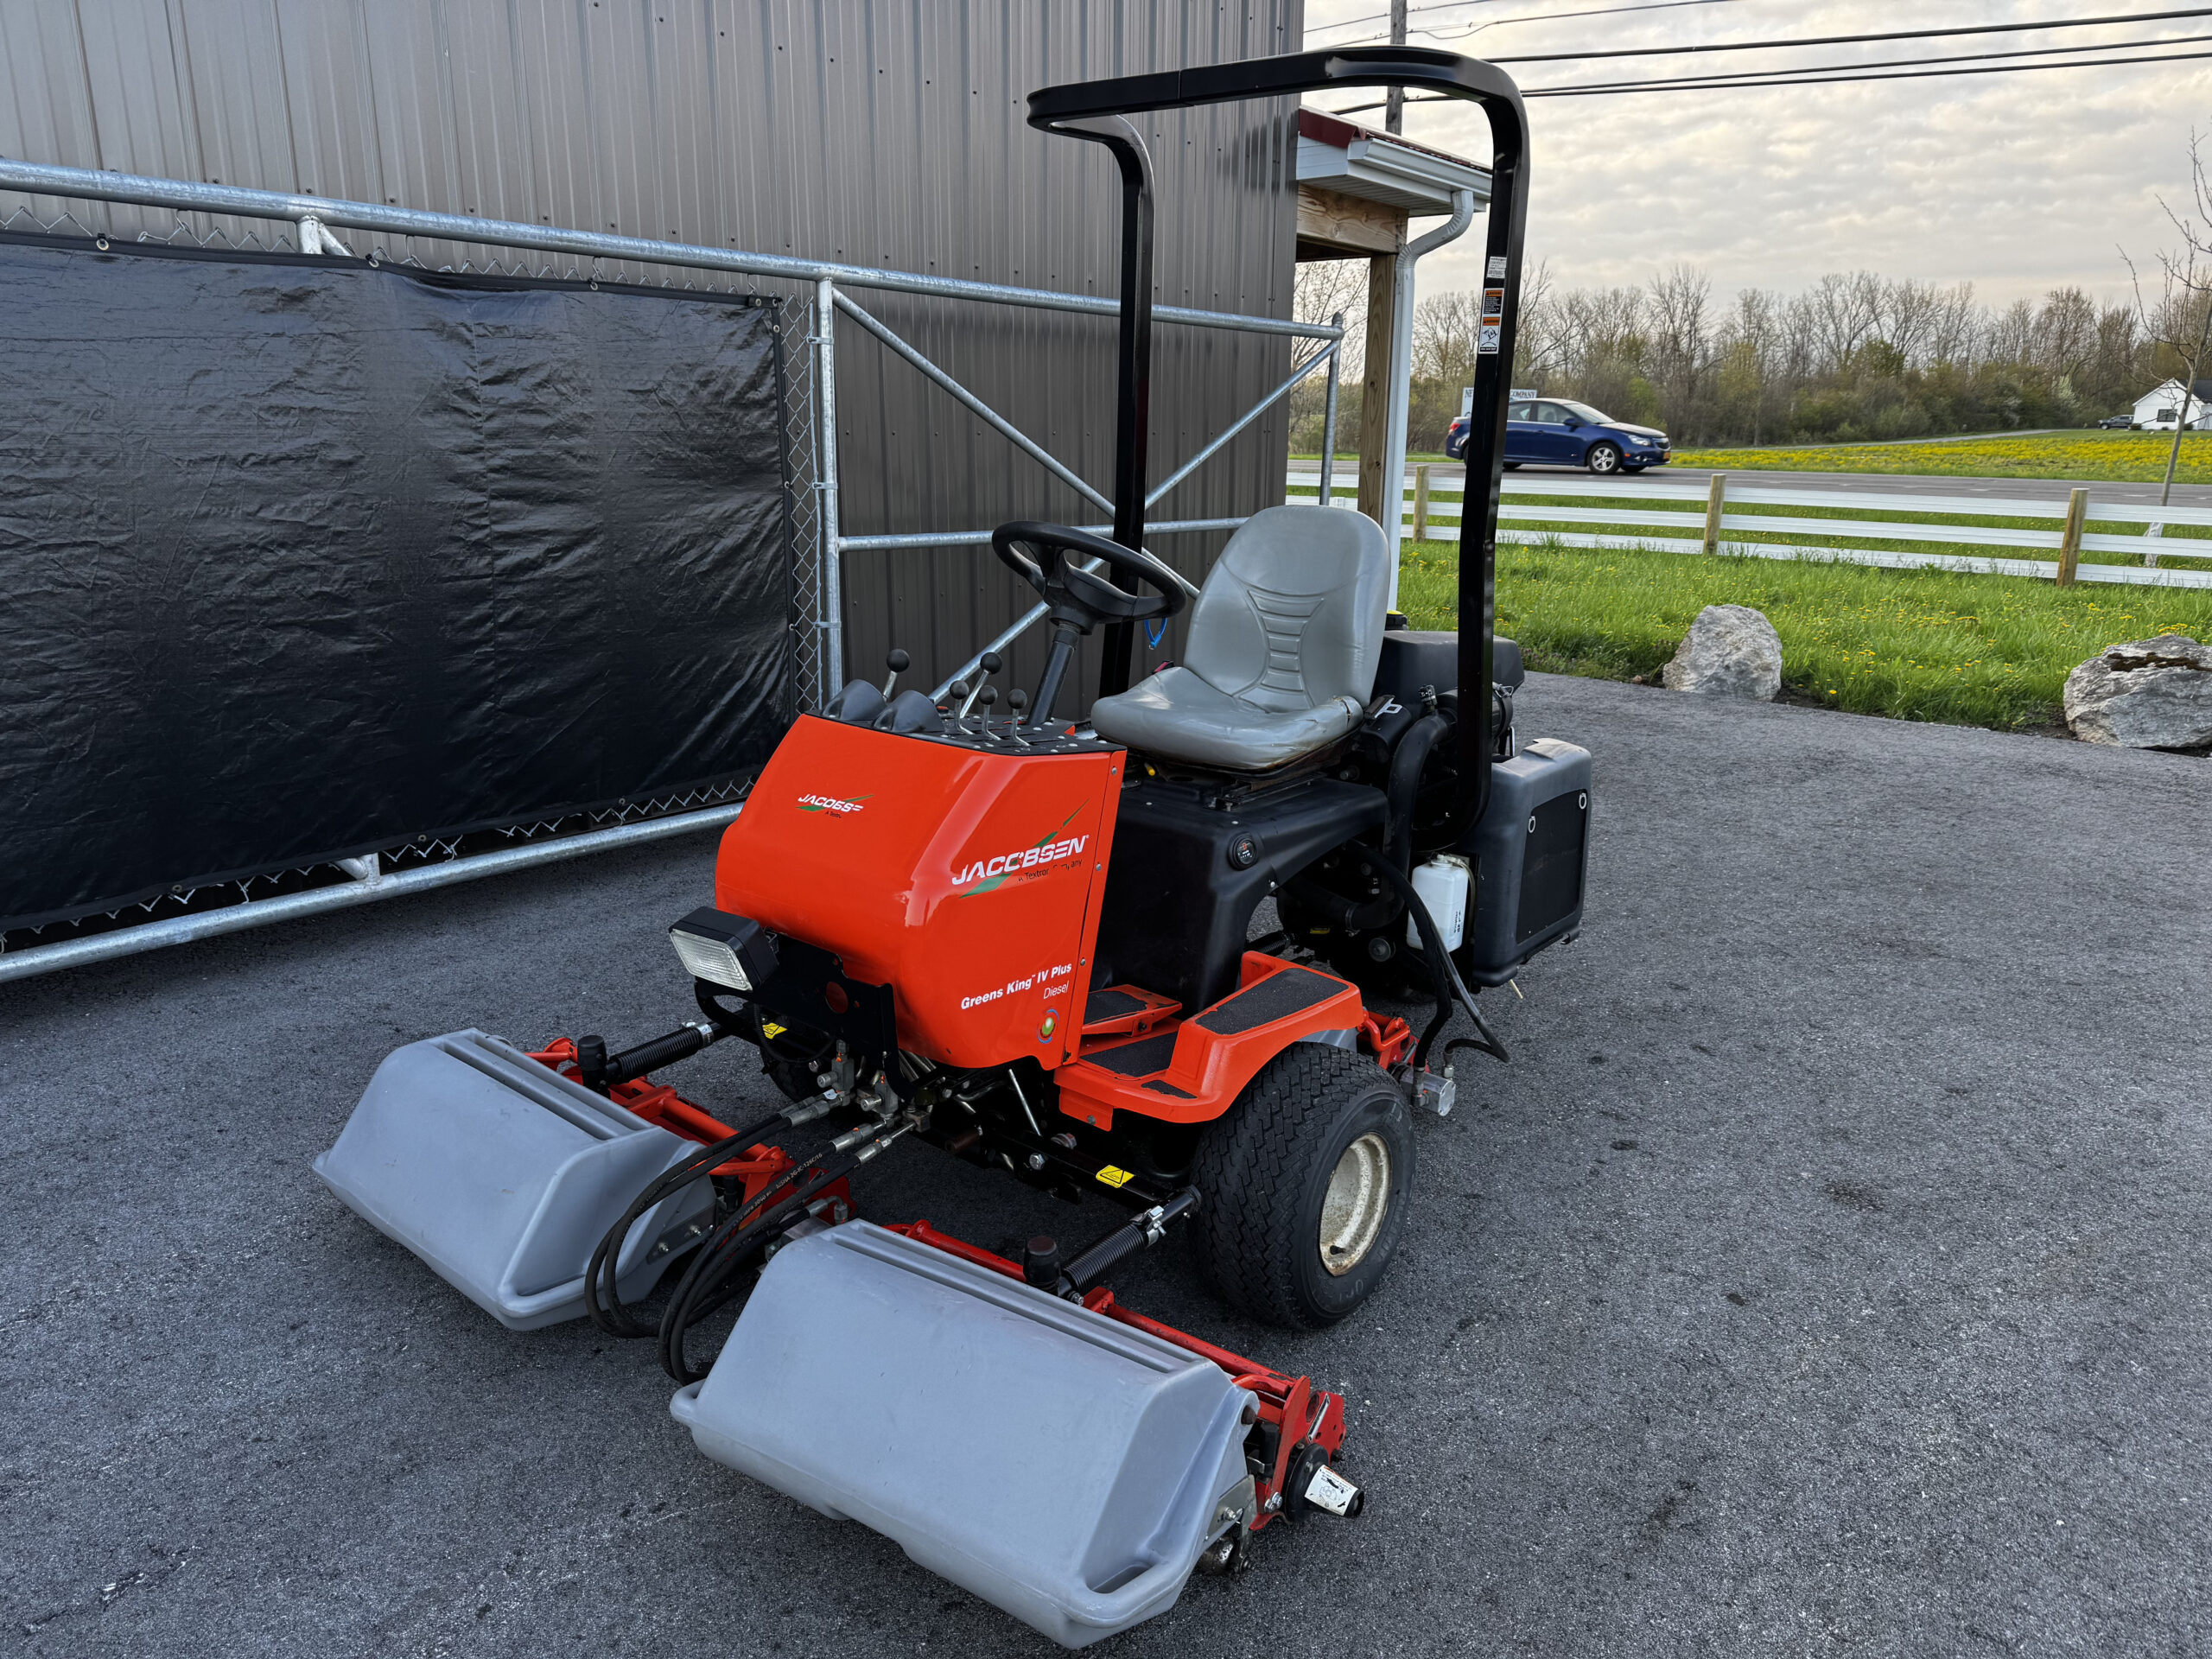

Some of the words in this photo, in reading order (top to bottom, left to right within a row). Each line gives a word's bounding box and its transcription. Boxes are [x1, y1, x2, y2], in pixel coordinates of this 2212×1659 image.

[798, 794, 864, 812] JACOBSE
[951, 835, 1089, 886] JACOBSEN
[961, 988, 1003, 1010] Greens
[1007, 977, 1033, 995] King
[1037, 969, 1050, 984] IV
[1051, 963, 1072, 979] Plus
[1043, 980, 1071, 1000] Diesel
